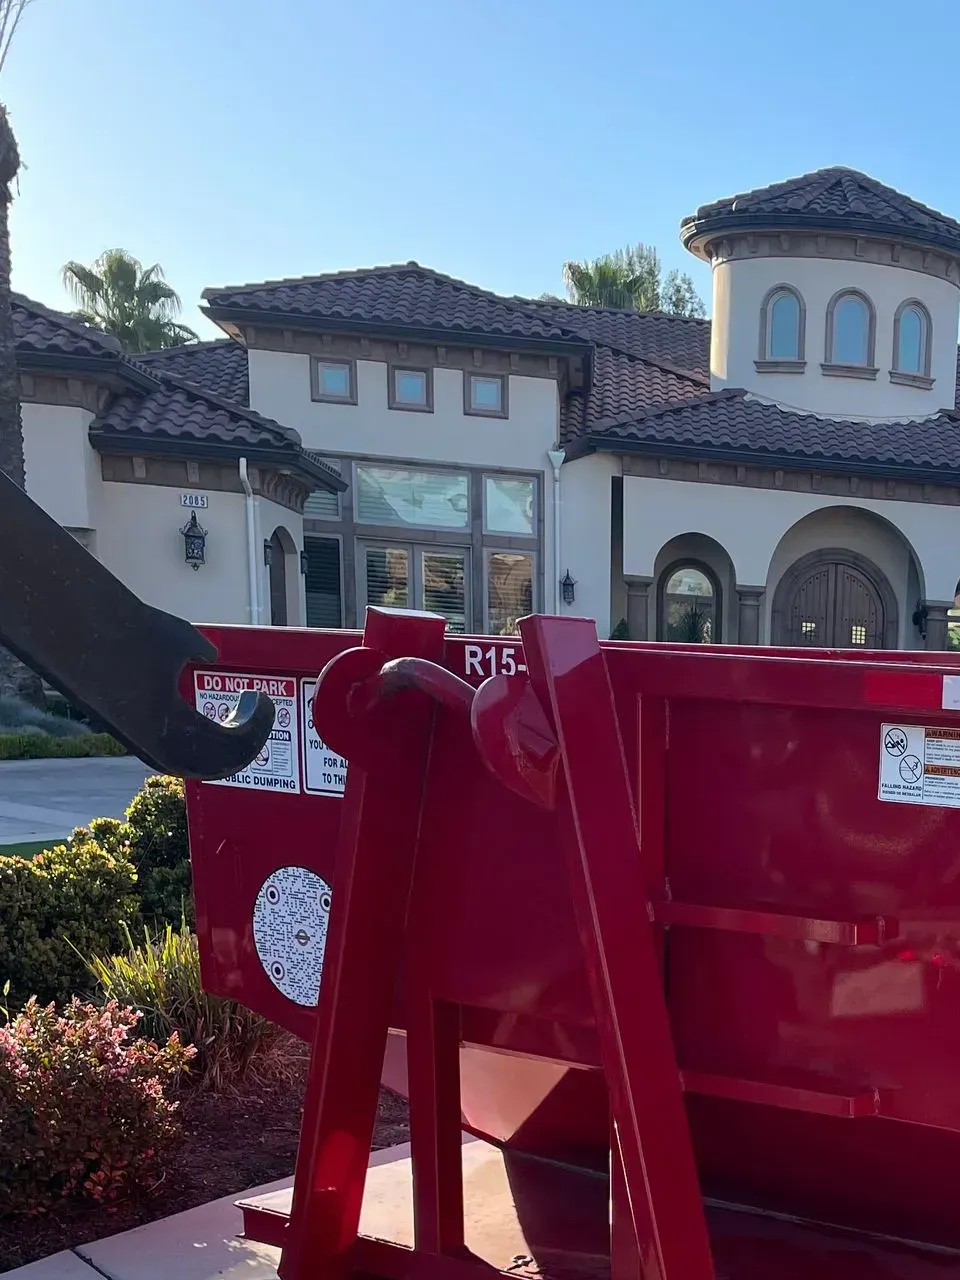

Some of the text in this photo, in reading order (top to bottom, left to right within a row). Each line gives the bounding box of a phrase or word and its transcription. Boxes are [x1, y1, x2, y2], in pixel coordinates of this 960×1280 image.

[183, 495, 205, 506] 2085
[203, 675, 287, 696] DO NOT PARK
[309, 739, 323, 750] YOU
[323, 757, 338, 768] FOR
[221, 774, 296, 789] UBLIC DUMPING
[322, 773, 332, 784] TO
